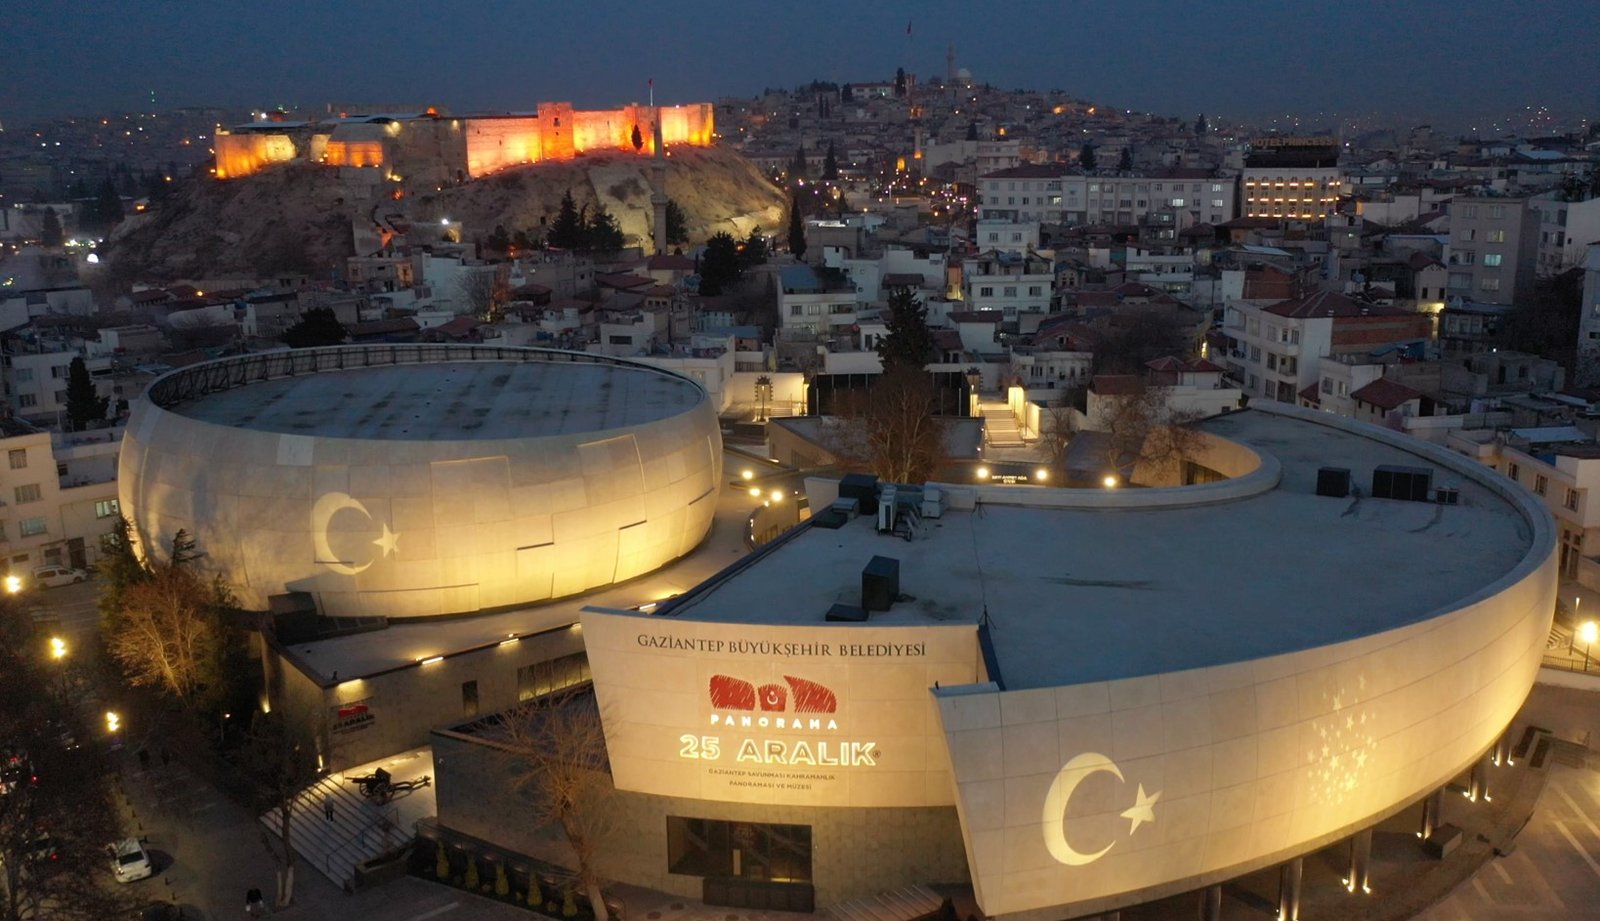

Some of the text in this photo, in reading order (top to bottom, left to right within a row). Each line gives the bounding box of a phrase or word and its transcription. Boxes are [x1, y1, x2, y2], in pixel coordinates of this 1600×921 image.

[637, 634, 926, 658] GAZİANTEP BÜYÜKŞEHİR BELEDİYESİ
[710, 714, 838, 730] PANORAMA
[679, 733, 876, 767] 25 ARALIK
[748, 771, 785, 779] SAVUNMASI
[786, 773, 836, 781] KAHRAMANLIK
[729, 780, 775, 789] PANORAMASI
[786, 783, 812, 791] MÜZESİ
